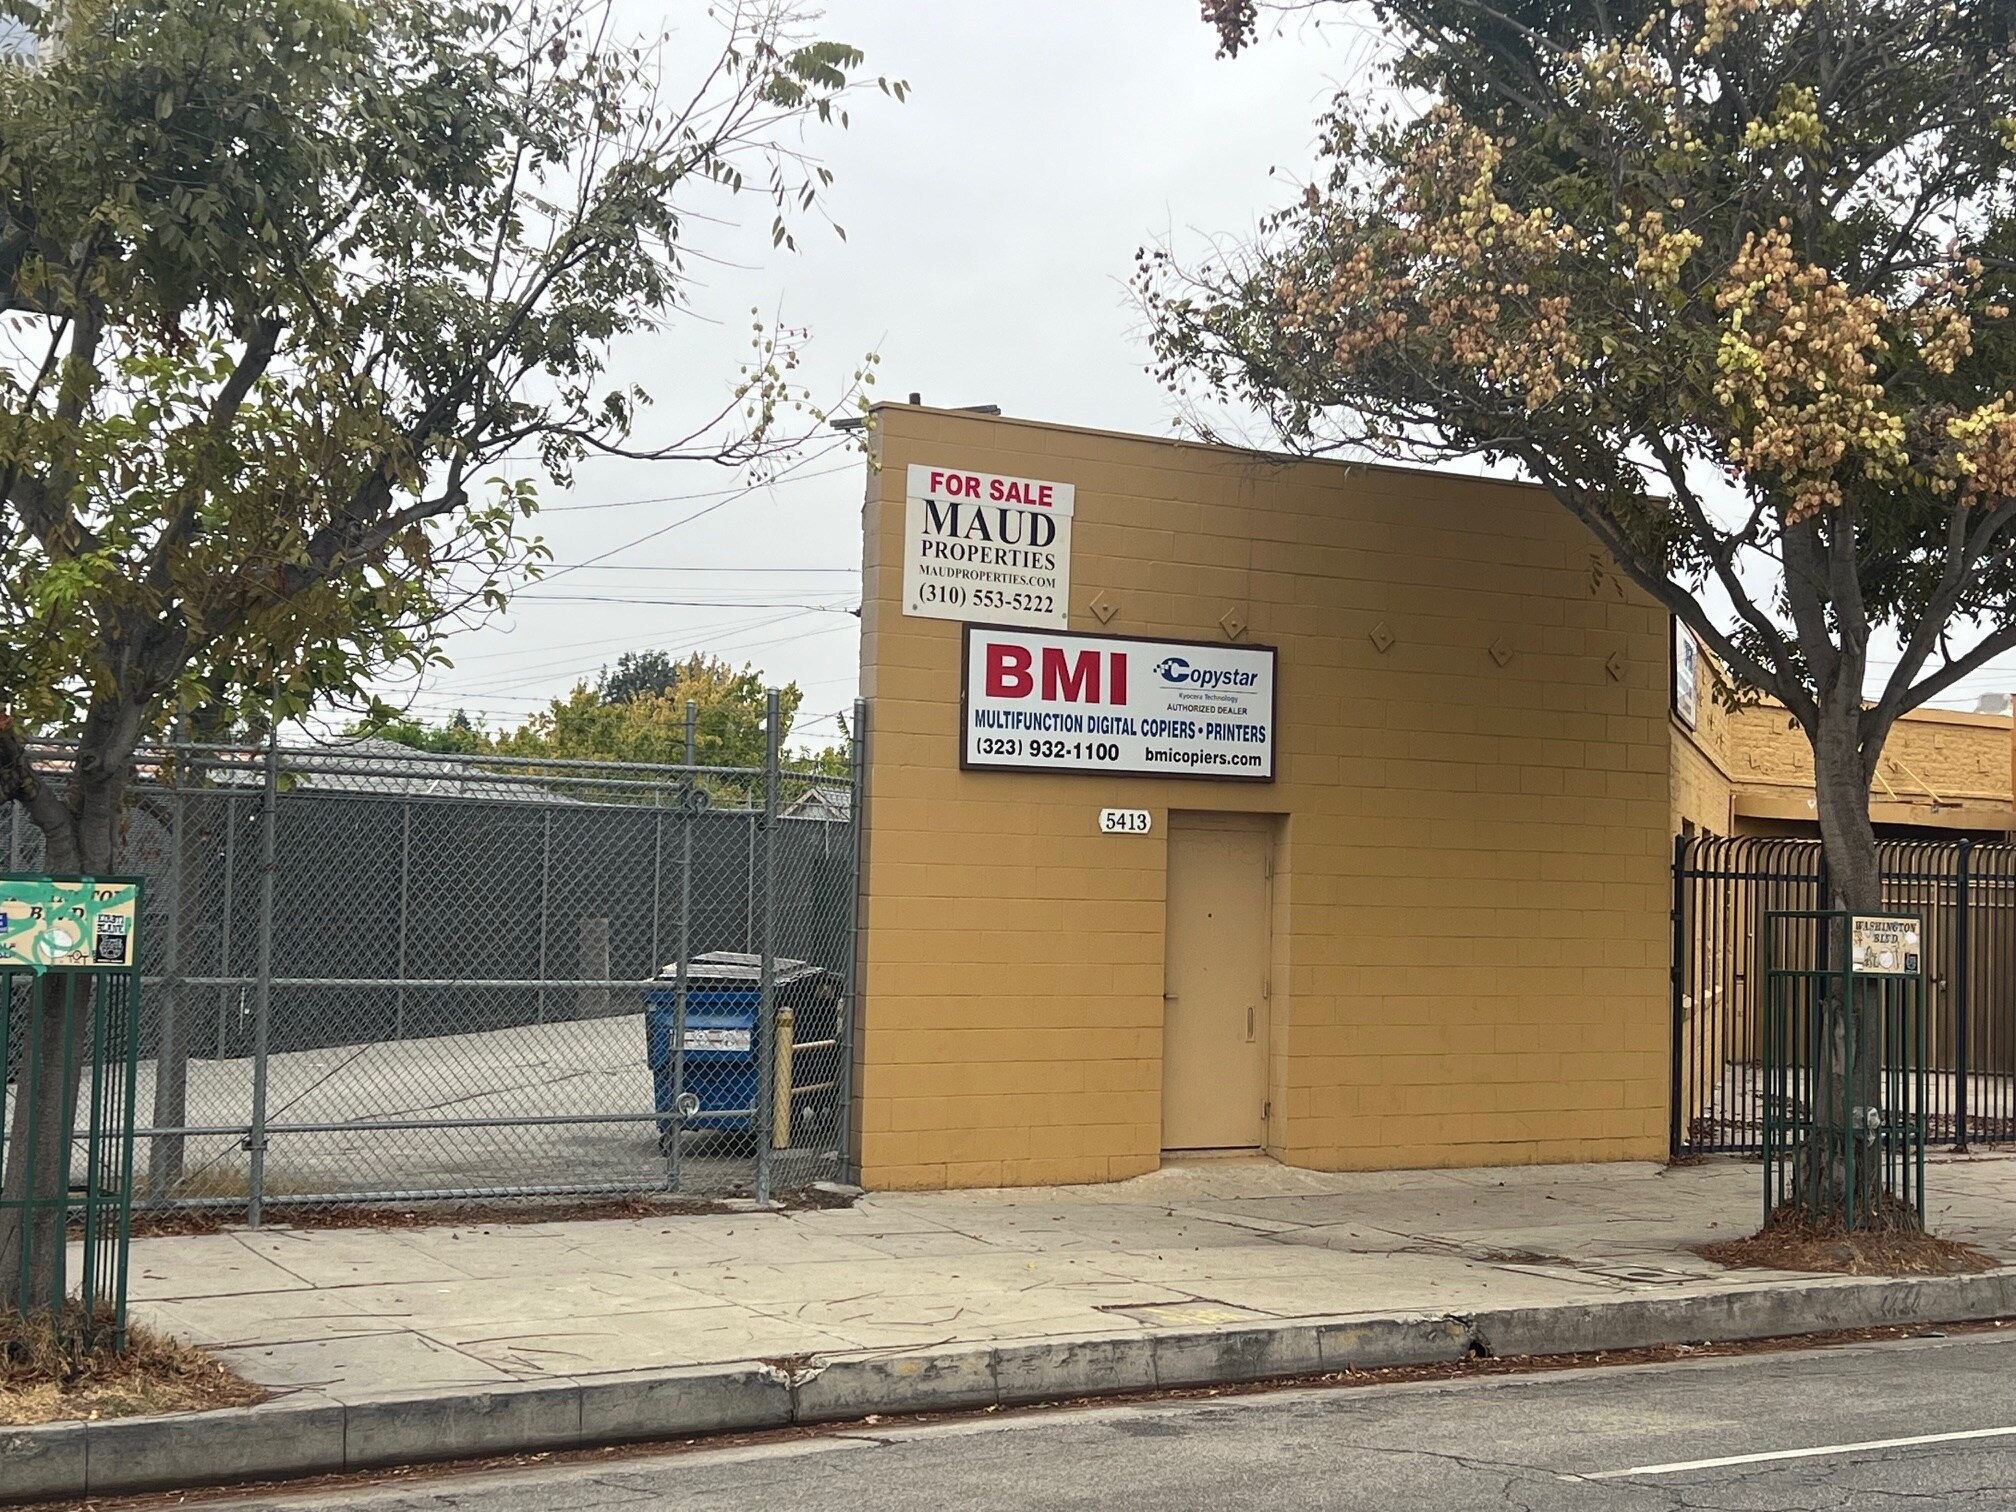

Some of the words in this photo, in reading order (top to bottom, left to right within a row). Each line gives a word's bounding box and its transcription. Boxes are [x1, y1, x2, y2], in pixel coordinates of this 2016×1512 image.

[930, 471, 981, 499] FOR
[989, 479, 1053, 507] SALE
[921, 499, 1056, 547] MAUD
[921, 540, 1055, 571] PROPERTIES
[919, 564, 1056, 588] MAUDPROPERTIES.COM
[919, 582, 966, 607] (310)
[973, 589, 1054, 613] 553-5222
[985, 642, 1127, 706] BMI
[1153, 657, 1258, 688] Copystar
[1166, 703, 1216, 714] AUTHORIZED
[1217, 706, 1248, 715] DEALER
[1178, 693, 1203, 701] Kyocera
[1204, 694, 1239, 704] Technology
[975, 709, 1083, 733] MULTIFUNCTION
[1087, 715, 1137, 736] DIGITAL
[1141, 718, 1195, 739] COPIERS
[1206, 722, 1266, 744] PRINTERS
[976, 737, 1023, 756] (323)
[1029, 739, 1119, 761] 932-1100
[1145, 747, 1262, 767] bmicopiers.com
[1105, 812, 1147, 831] 5413
[1855, 921, 1916, 932] WASHINGTON
